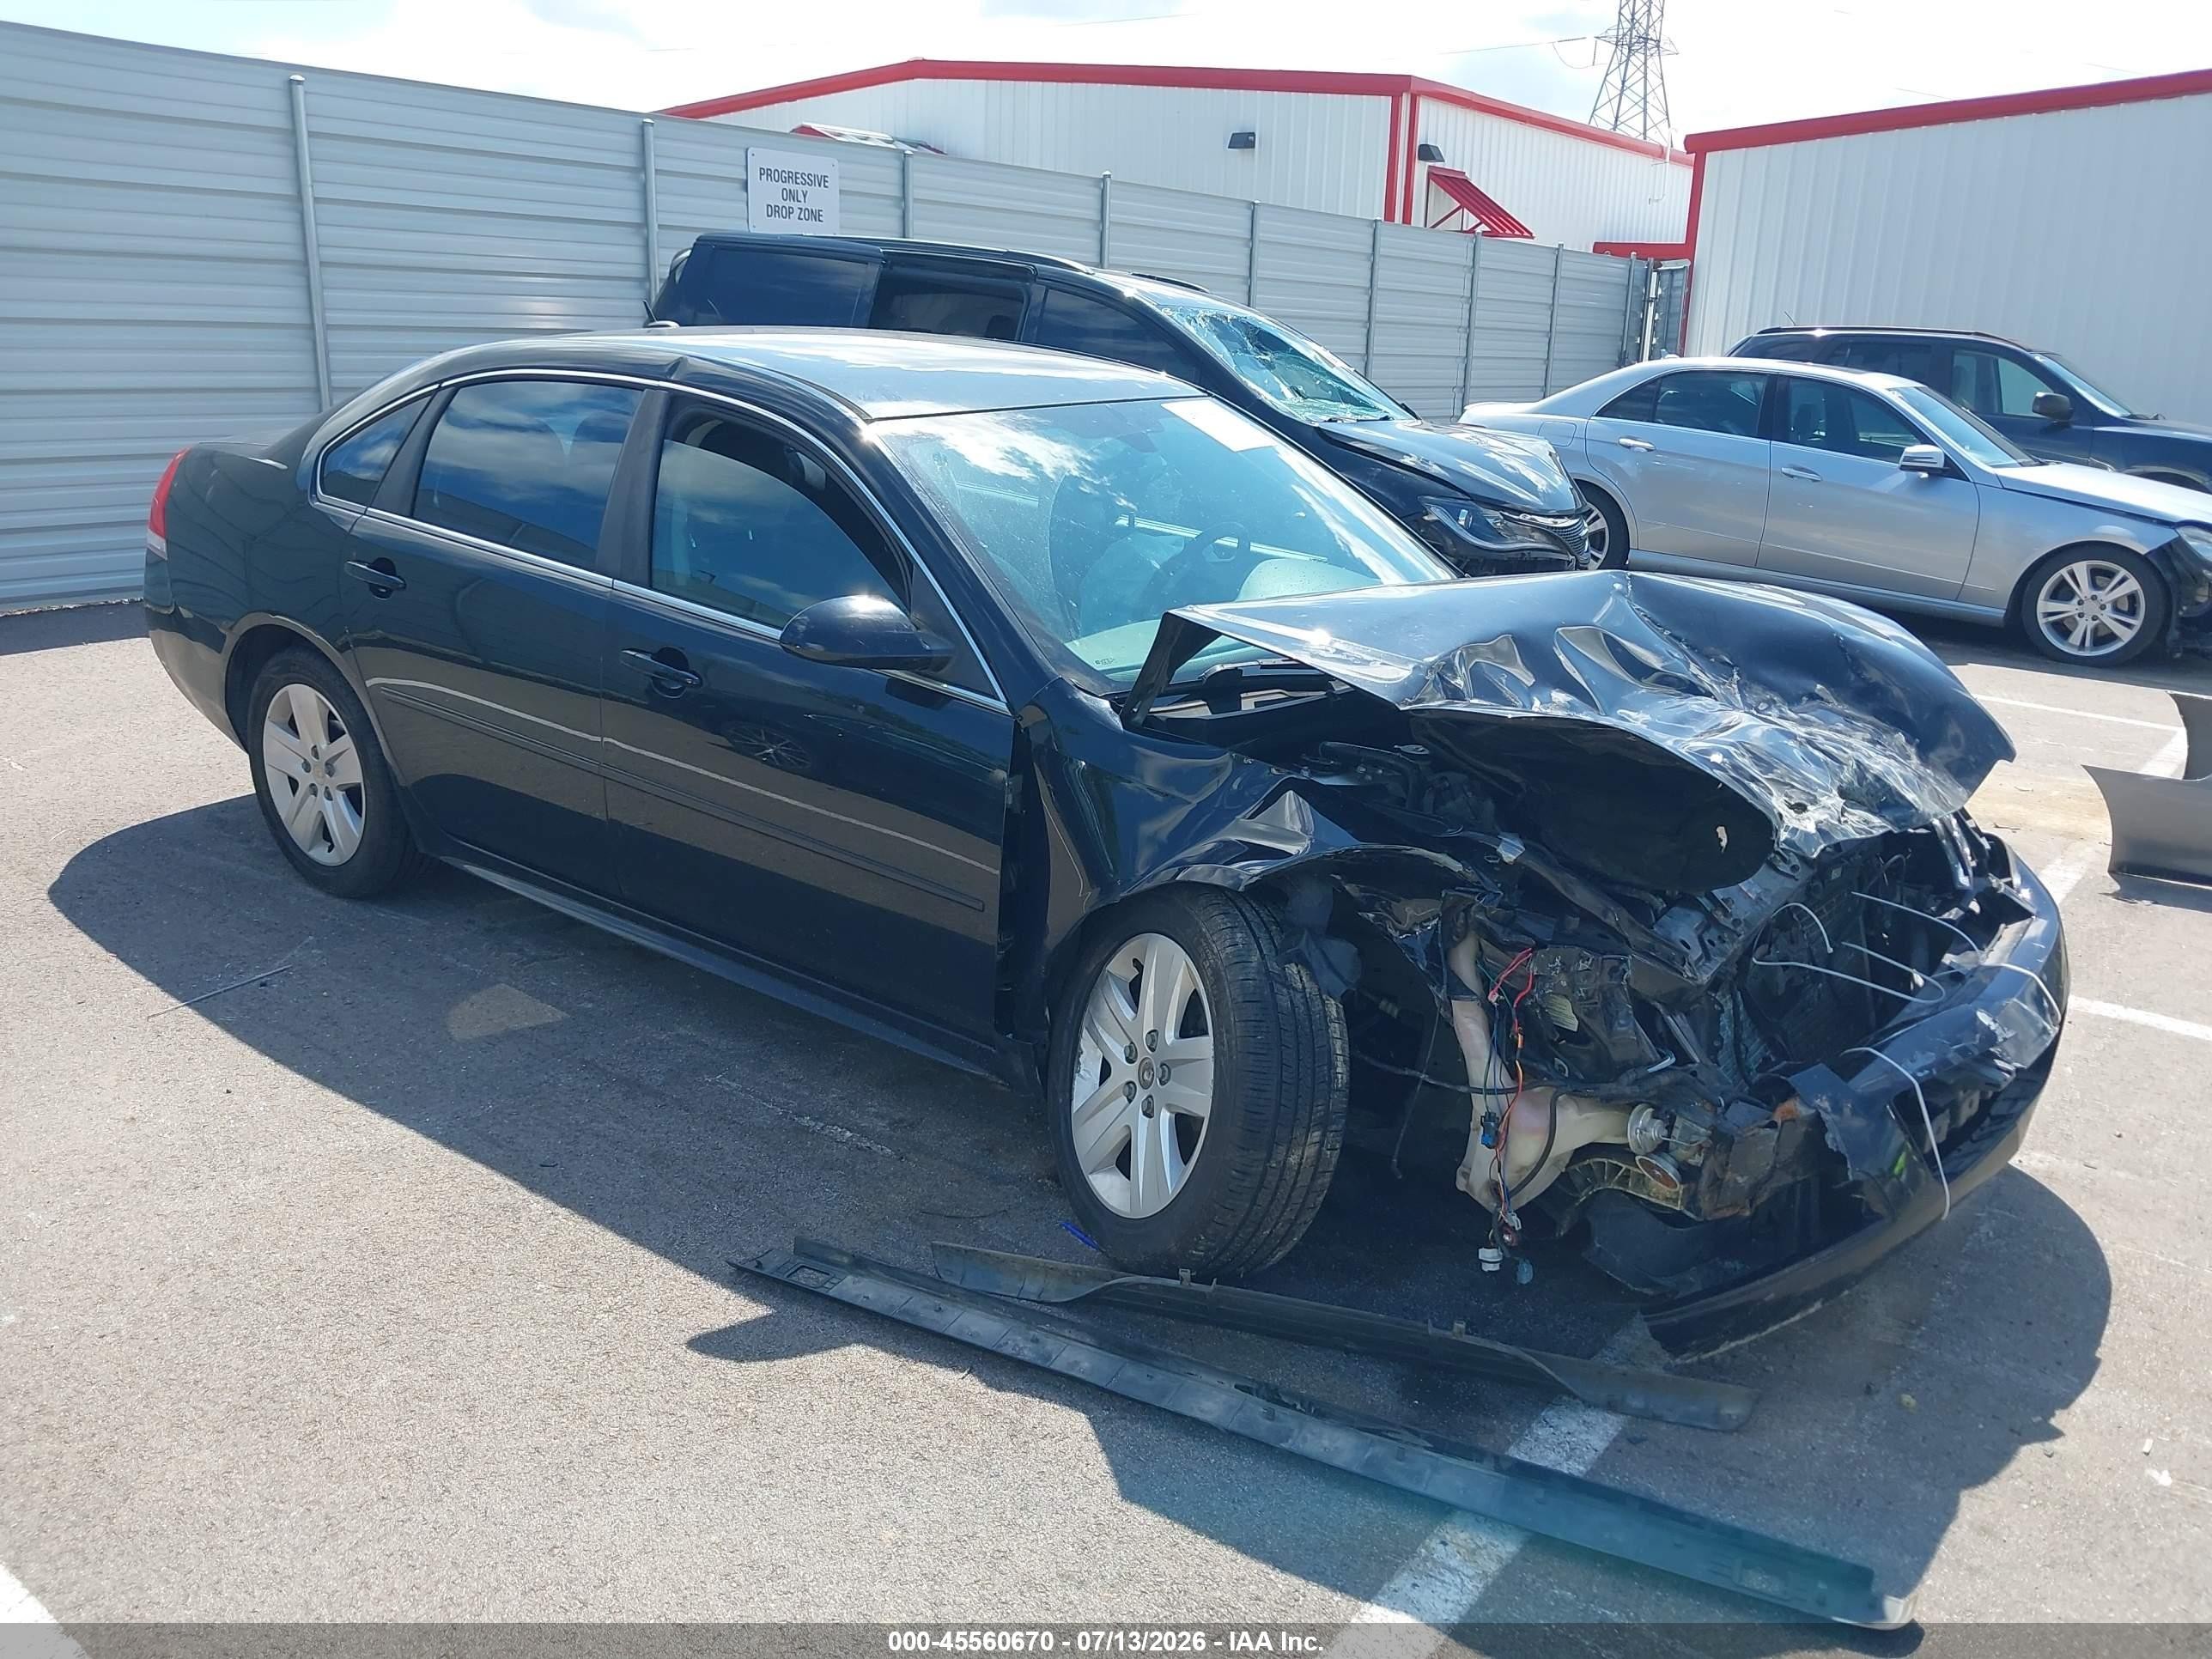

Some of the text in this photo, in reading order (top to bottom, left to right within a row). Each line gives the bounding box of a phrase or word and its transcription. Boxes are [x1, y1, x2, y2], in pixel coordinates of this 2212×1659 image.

[759, 167, 829, 188] PROGRESSIVE
[781, 188, 808, 203] ONLY
[766, 204, 823, 222] DROP ZONE
